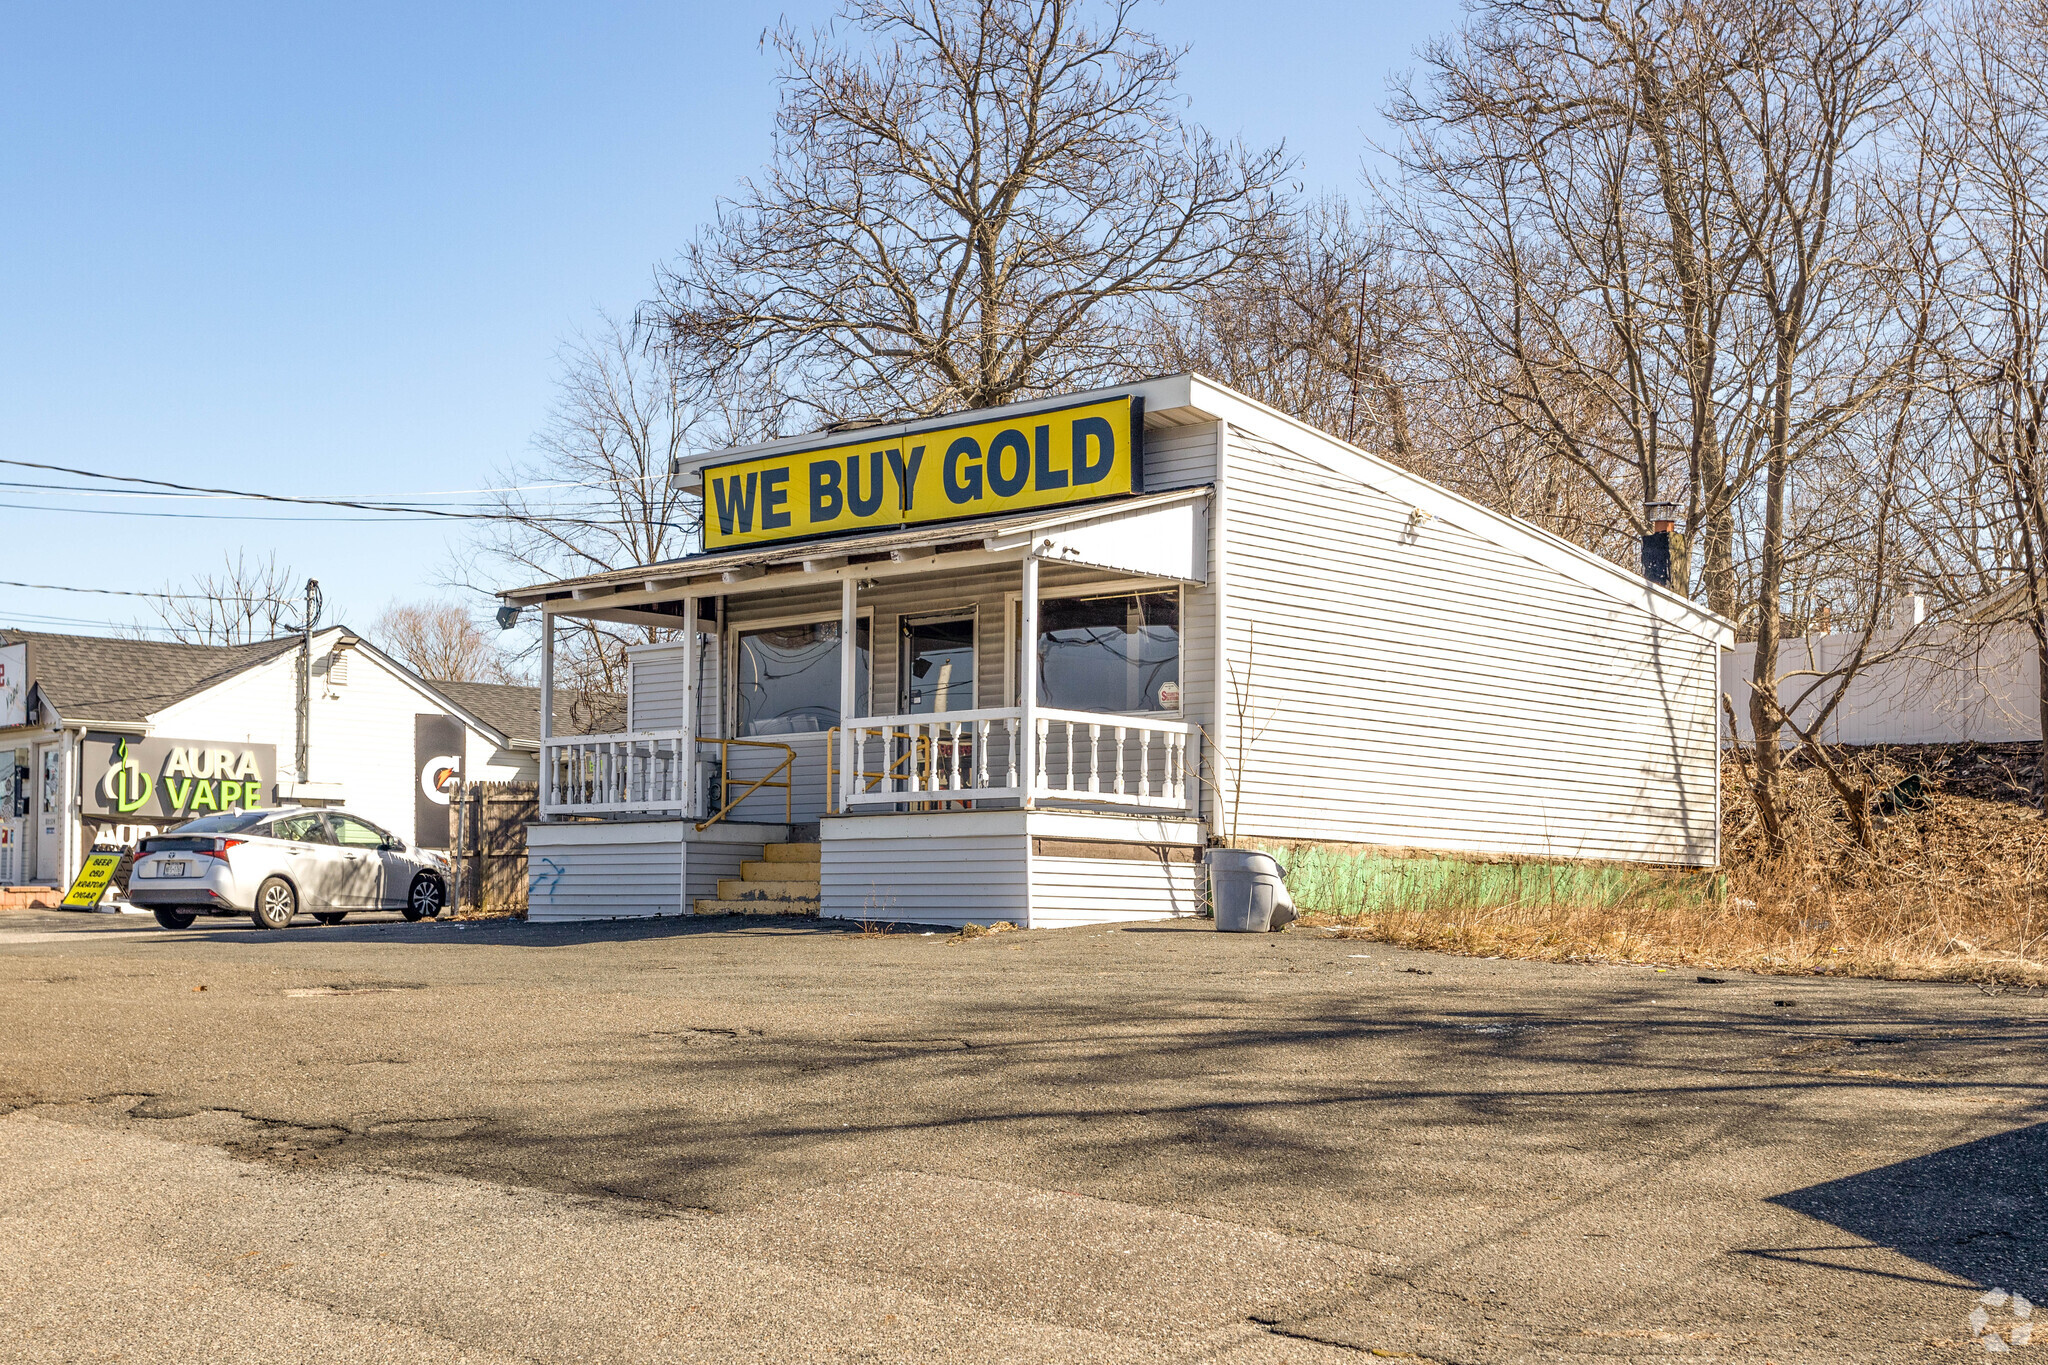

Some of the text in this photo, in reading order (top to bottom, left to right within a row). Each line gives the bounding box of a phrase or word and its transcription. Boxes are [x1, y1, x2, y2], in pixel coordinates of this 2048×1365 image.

[712, 416, 1115, 536] WE BUY GOLD
[164, 746, 262, 780] AURA
[165, 777, 262, 811] VAPE
[92, 858, 112, 867] BEER
[89, 870, 105, 878] CBD
[76, 881, 106, 889] KRATOM
[72, 891, 96, 899] CIGAR
